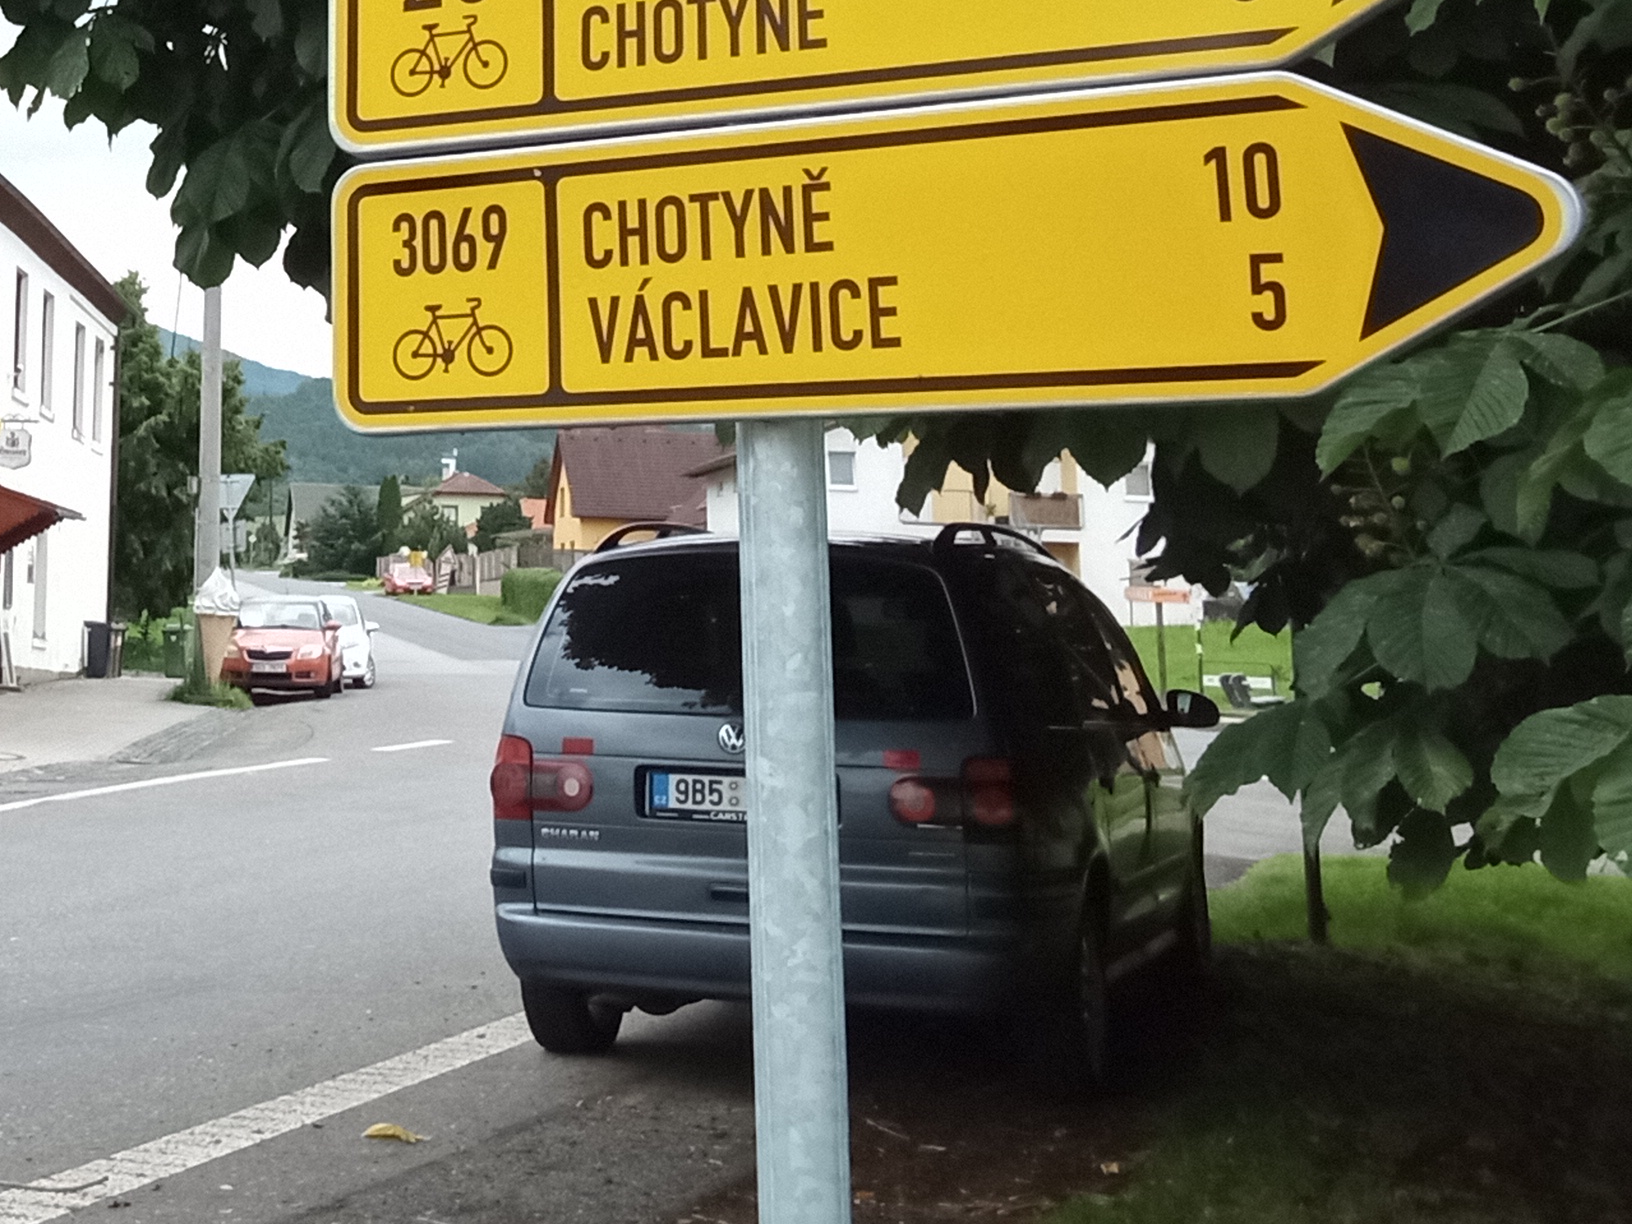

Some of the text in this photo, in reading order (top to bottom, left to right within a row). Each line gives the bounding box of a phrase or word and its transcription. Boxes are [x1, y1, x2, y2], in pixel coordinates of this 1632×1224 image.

[392, 204, 508, 278] 3069
[582, 141, 1282, 270] CHOTYNĚ 10
[587, 252, 1287, 364] VÁCLAVICE 5
[674, 777, 724, 807] 9B5
